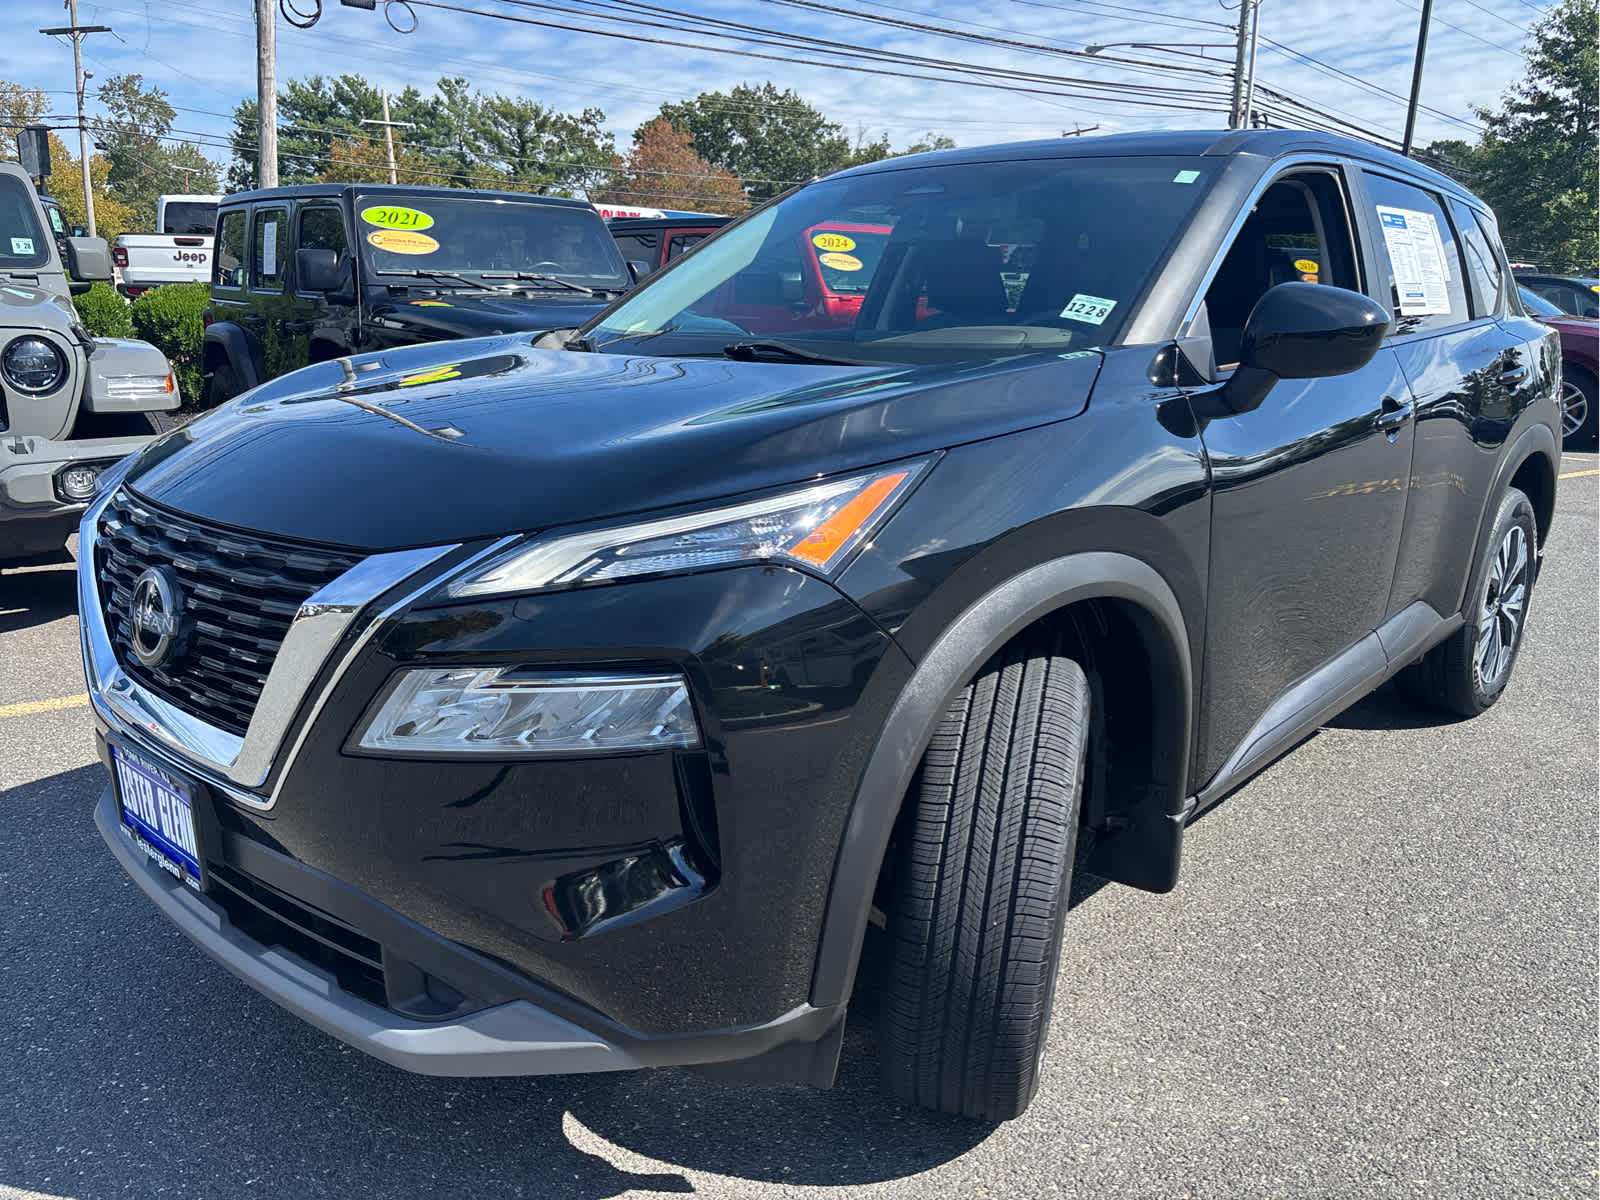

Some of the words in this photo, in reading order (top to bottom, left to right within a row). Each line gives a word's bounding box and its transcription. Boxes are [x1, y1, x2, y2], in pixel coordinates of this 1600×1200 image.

[376, 211, 419, 225] 2021
[820, 237, 849, 249] 2024
[173, 250, 207, 265] Jeep
[115, 759, 158, 830] LESTER
[157, 787, 199, 859] GLENN
